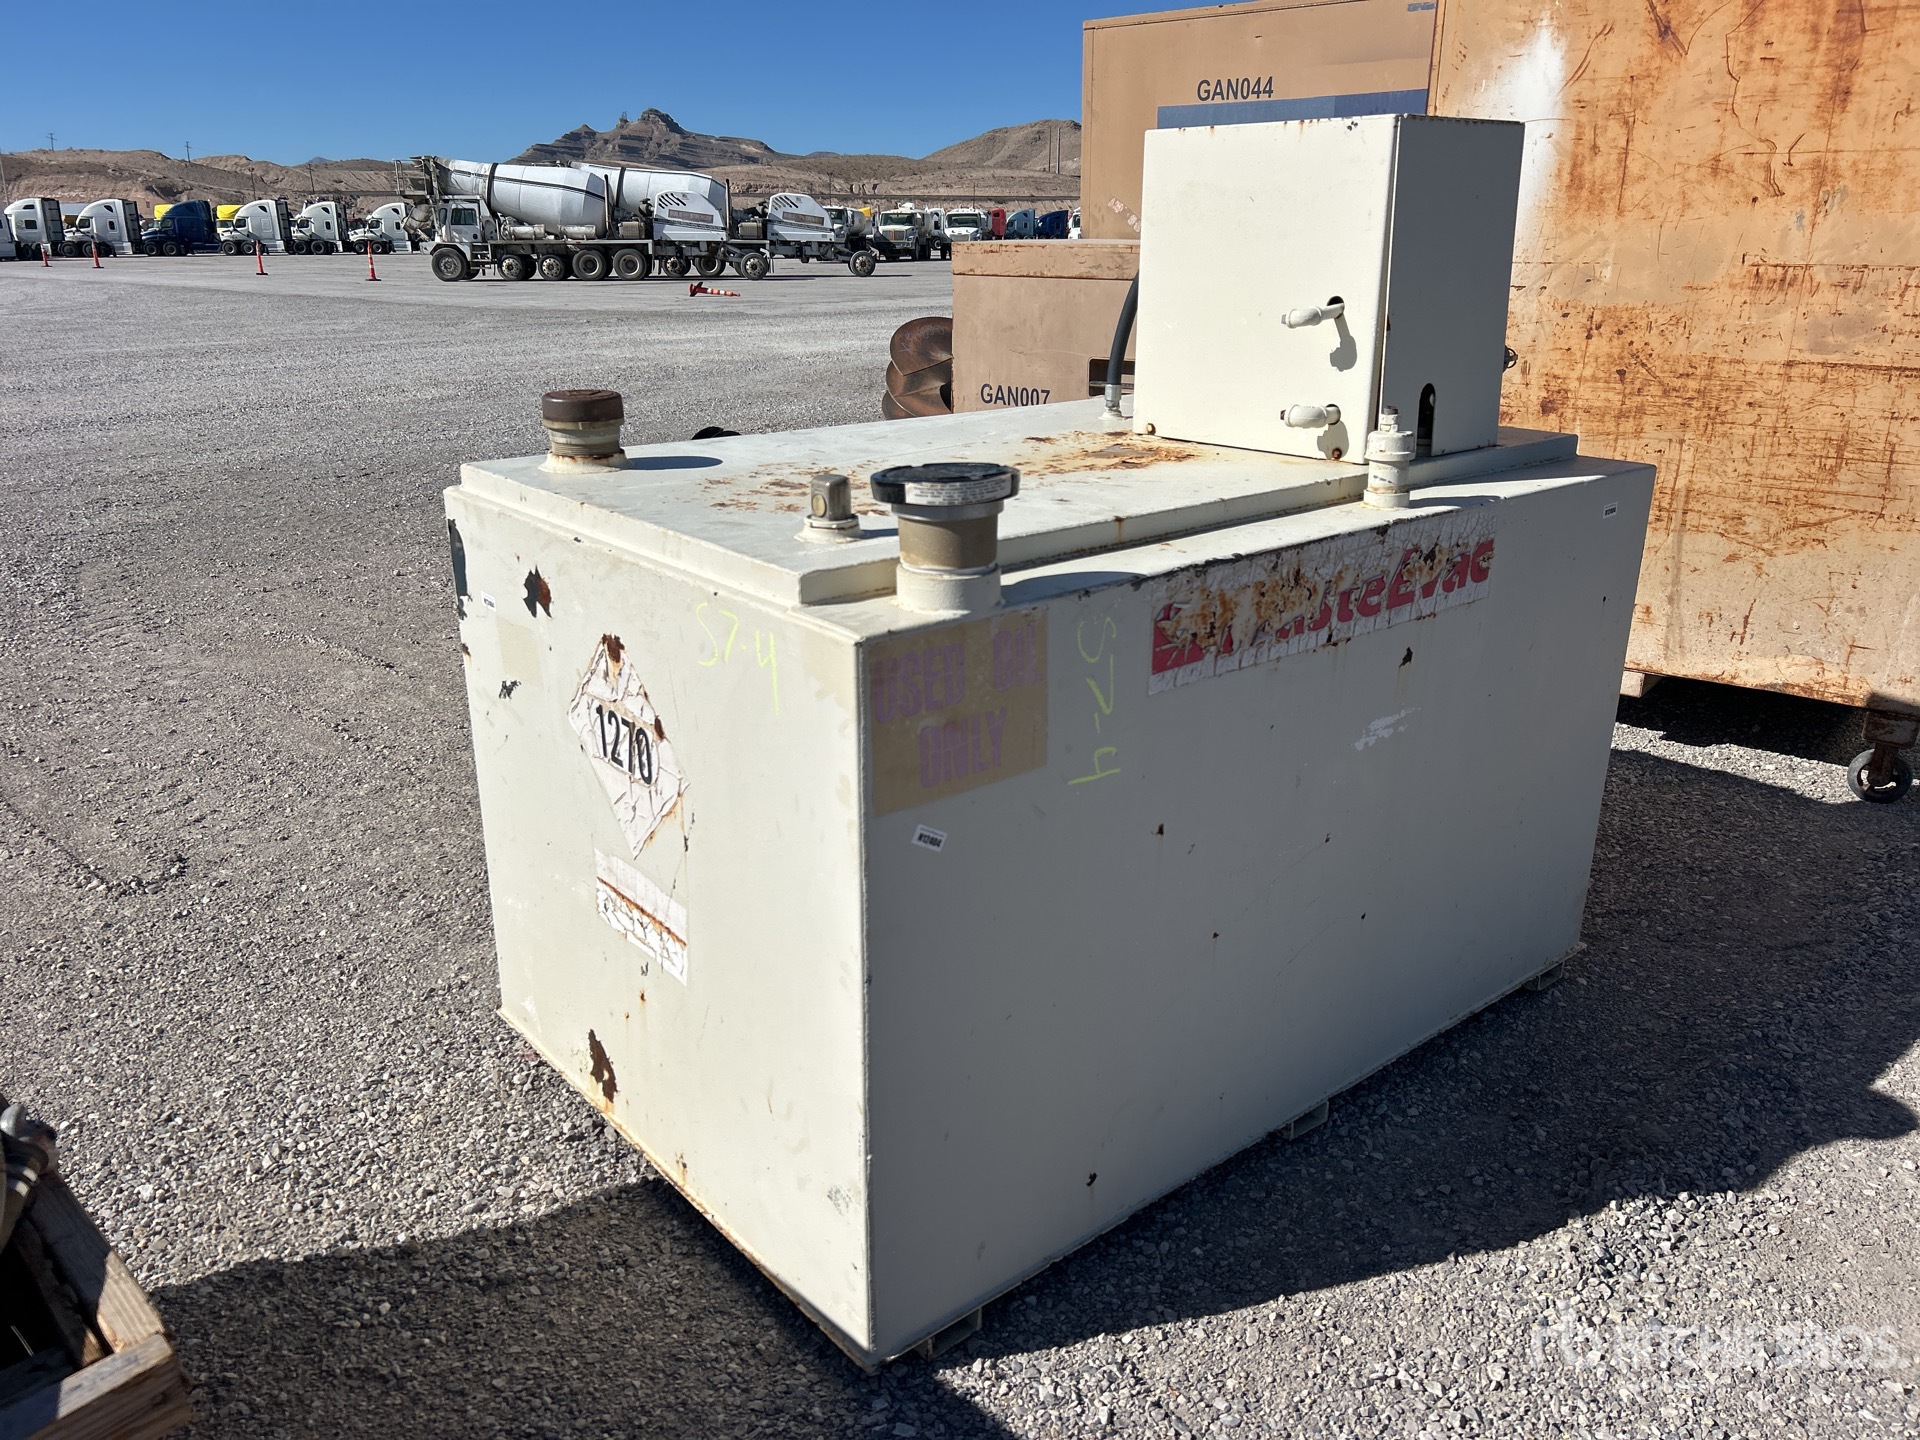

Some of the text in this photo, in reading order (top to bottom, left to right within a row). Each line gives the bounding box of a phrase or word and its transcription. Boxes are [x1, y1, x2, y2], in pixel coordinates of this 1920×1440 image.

[1197, 76, 1274, 102] GAN044
[980, 383, 1051, 407] GAN007
[871, 623, 1045, 725] USED OIL
[595, 704, 653, 786] 1270
[918, 707, 1008, 790] ONLY
